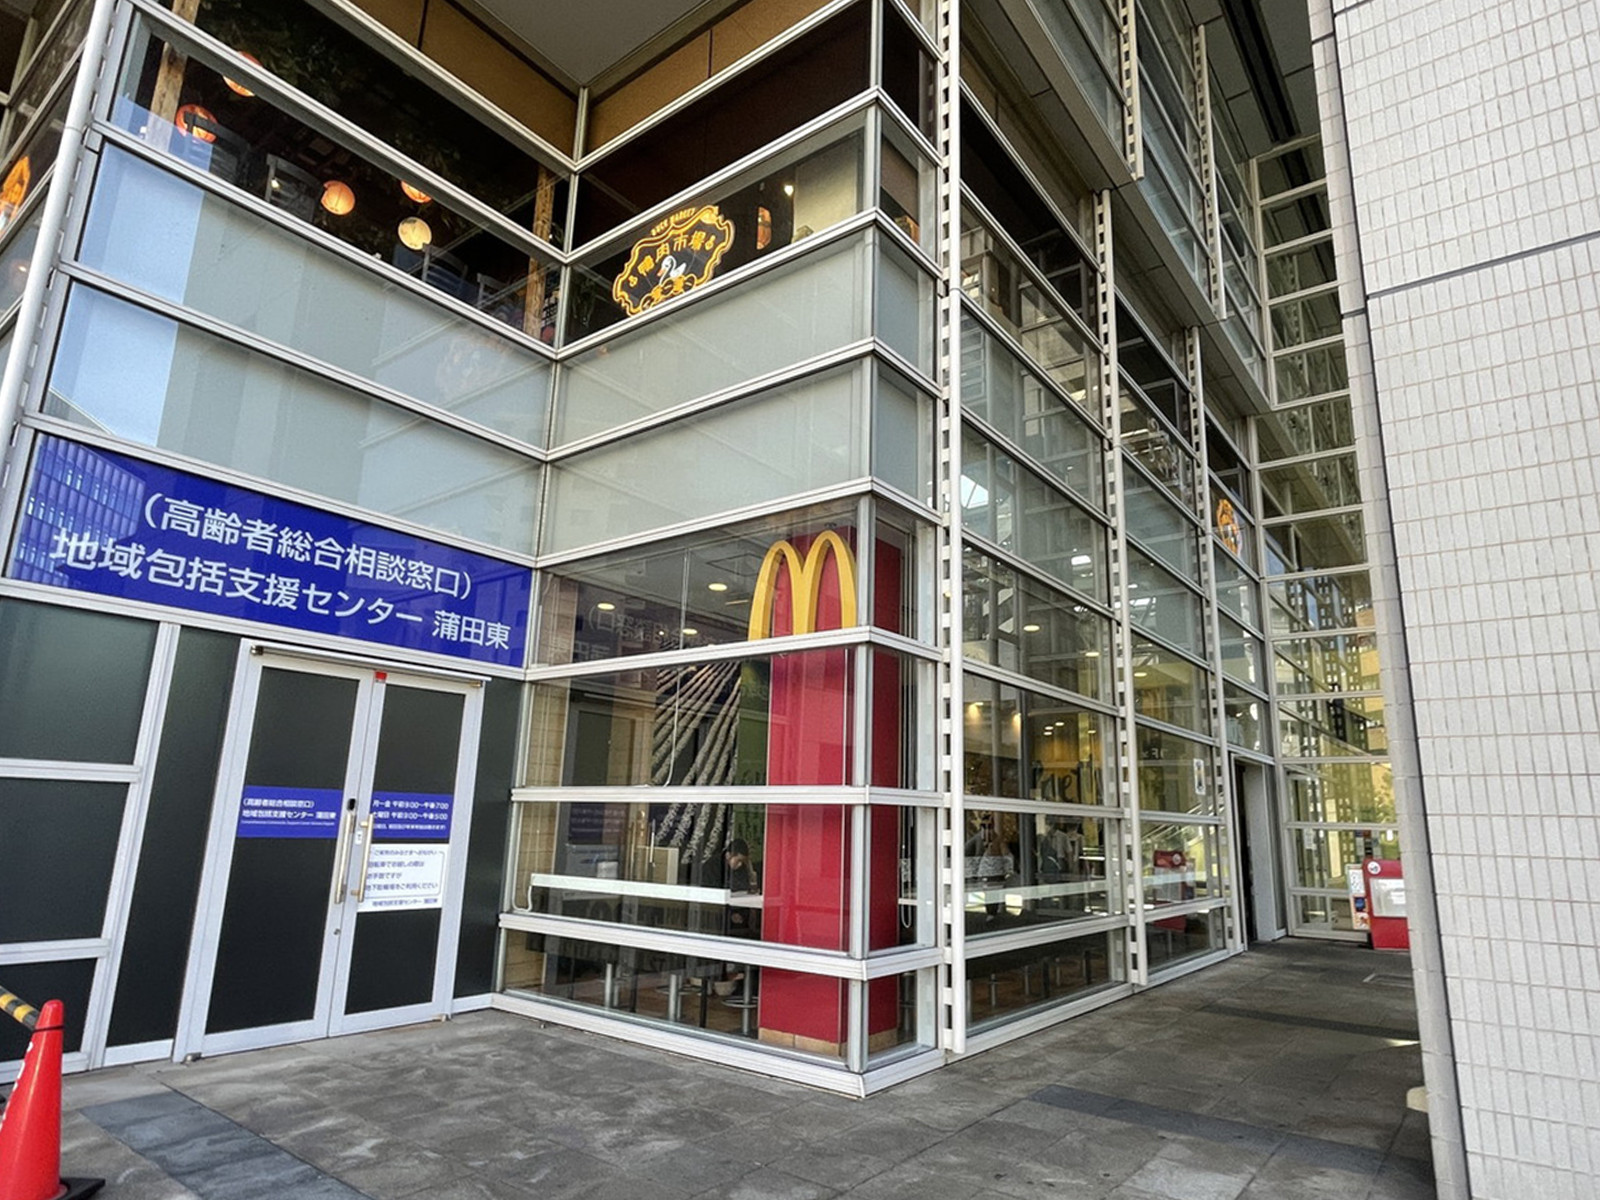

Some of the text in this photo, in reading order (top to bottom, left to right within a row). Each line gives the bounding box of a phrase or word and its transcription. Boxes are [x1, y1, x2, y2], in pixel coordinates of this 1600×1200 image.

[51, 527, 423, 625] 地域包括支援センター
[432, 610, 511, 650] 蒲田東
